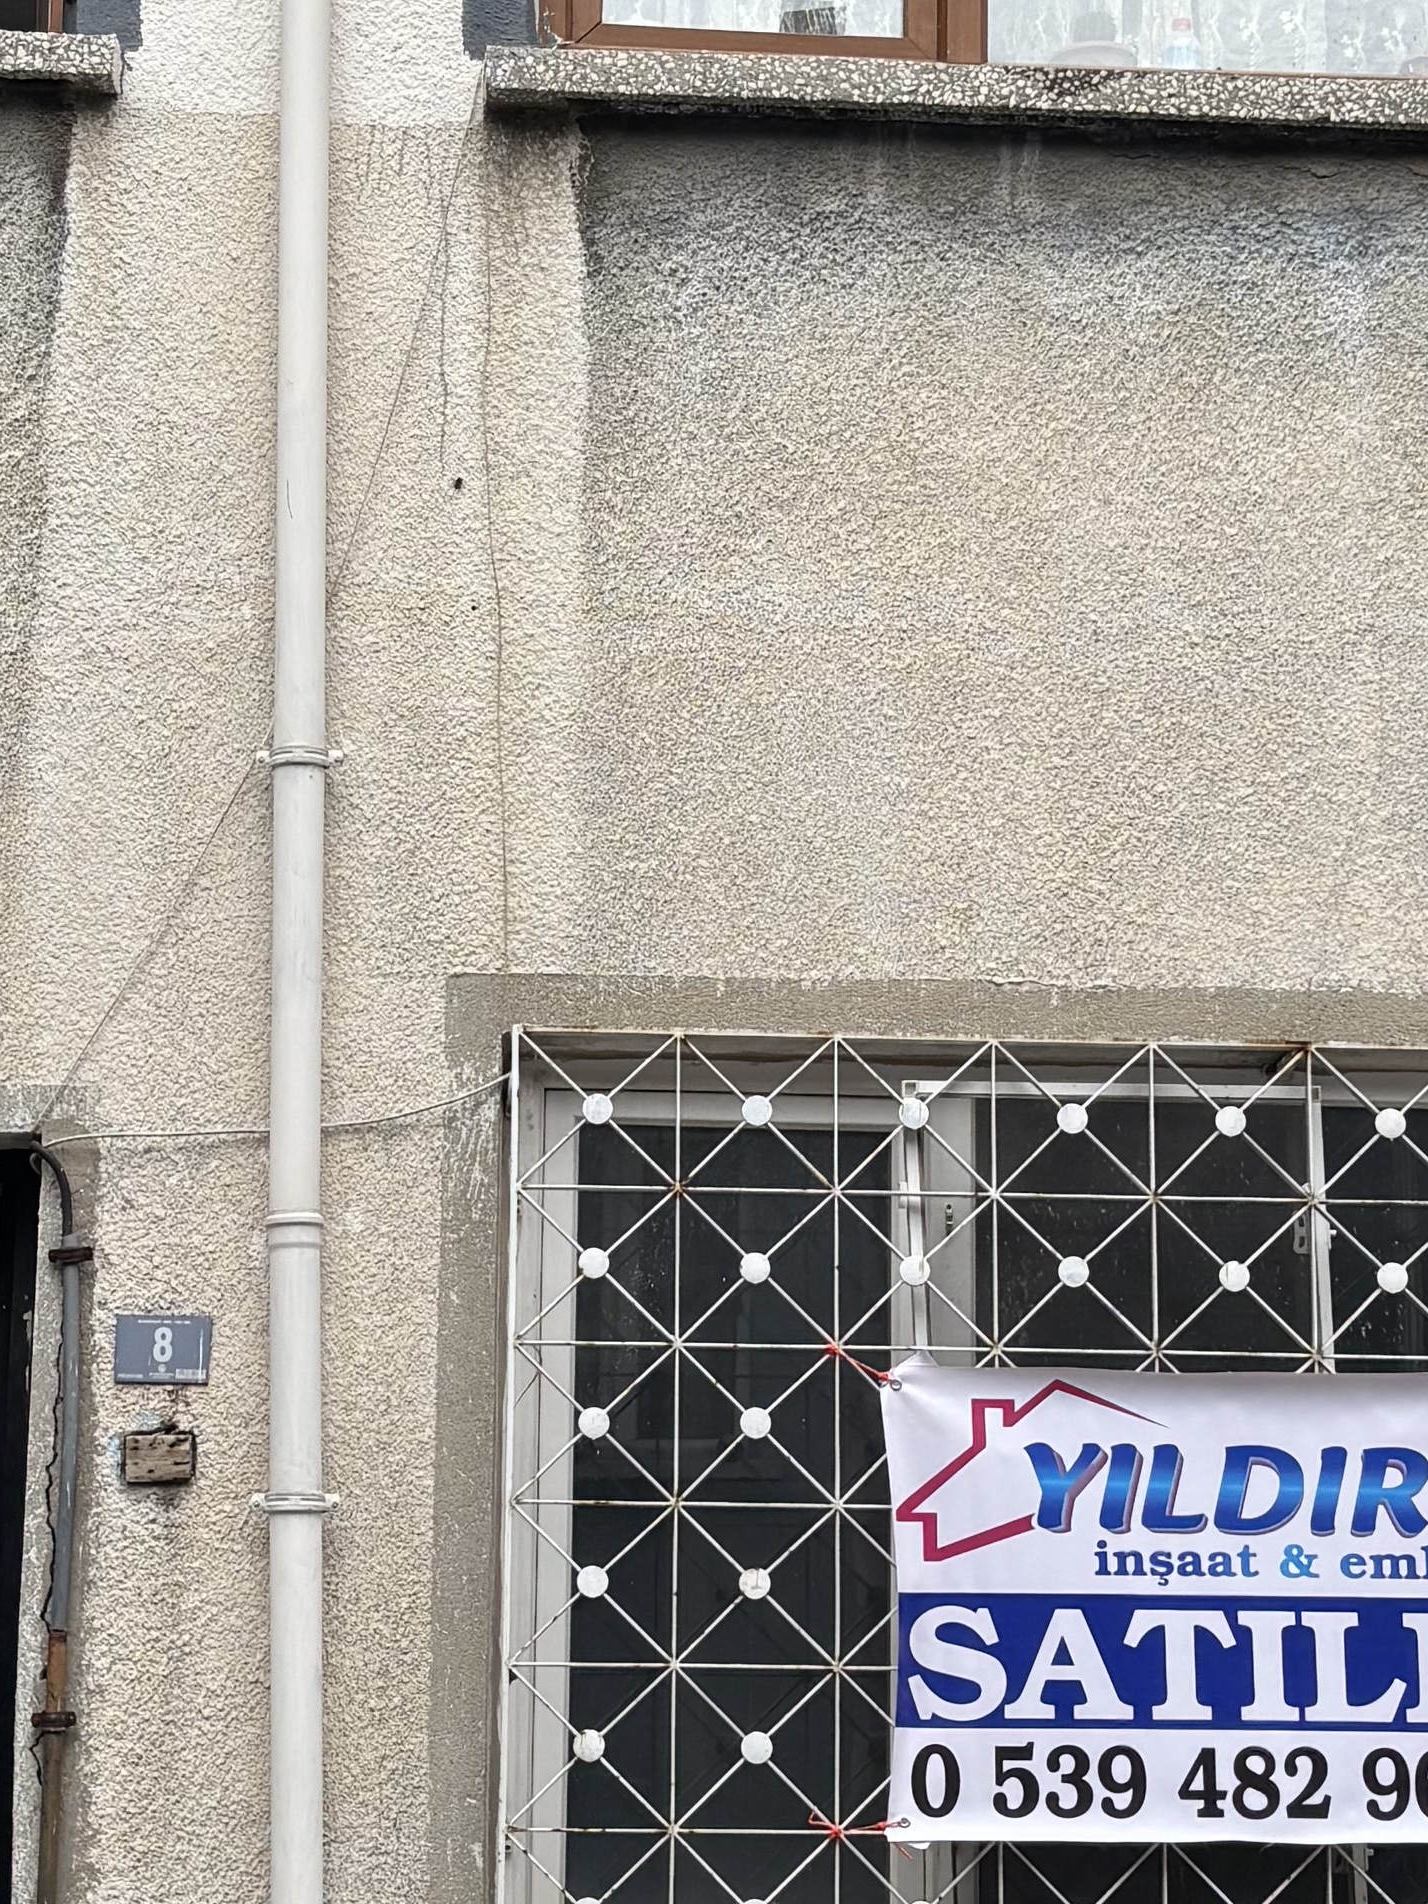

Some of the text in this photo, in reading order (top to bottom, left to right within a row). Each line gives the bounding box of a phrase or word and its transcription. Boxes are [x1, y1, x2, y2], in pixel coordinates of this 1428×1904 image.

[153, 1326, 173, 1363] 8
[1094, 1539, 1259, 1586] inşaat
[1280, 1543, 1320, 1580] &
[911, 1743, 962, 1819] 0
[992, 1742, 1148, 1820] 539
[1178, 1745, 1332, 1820] 482
